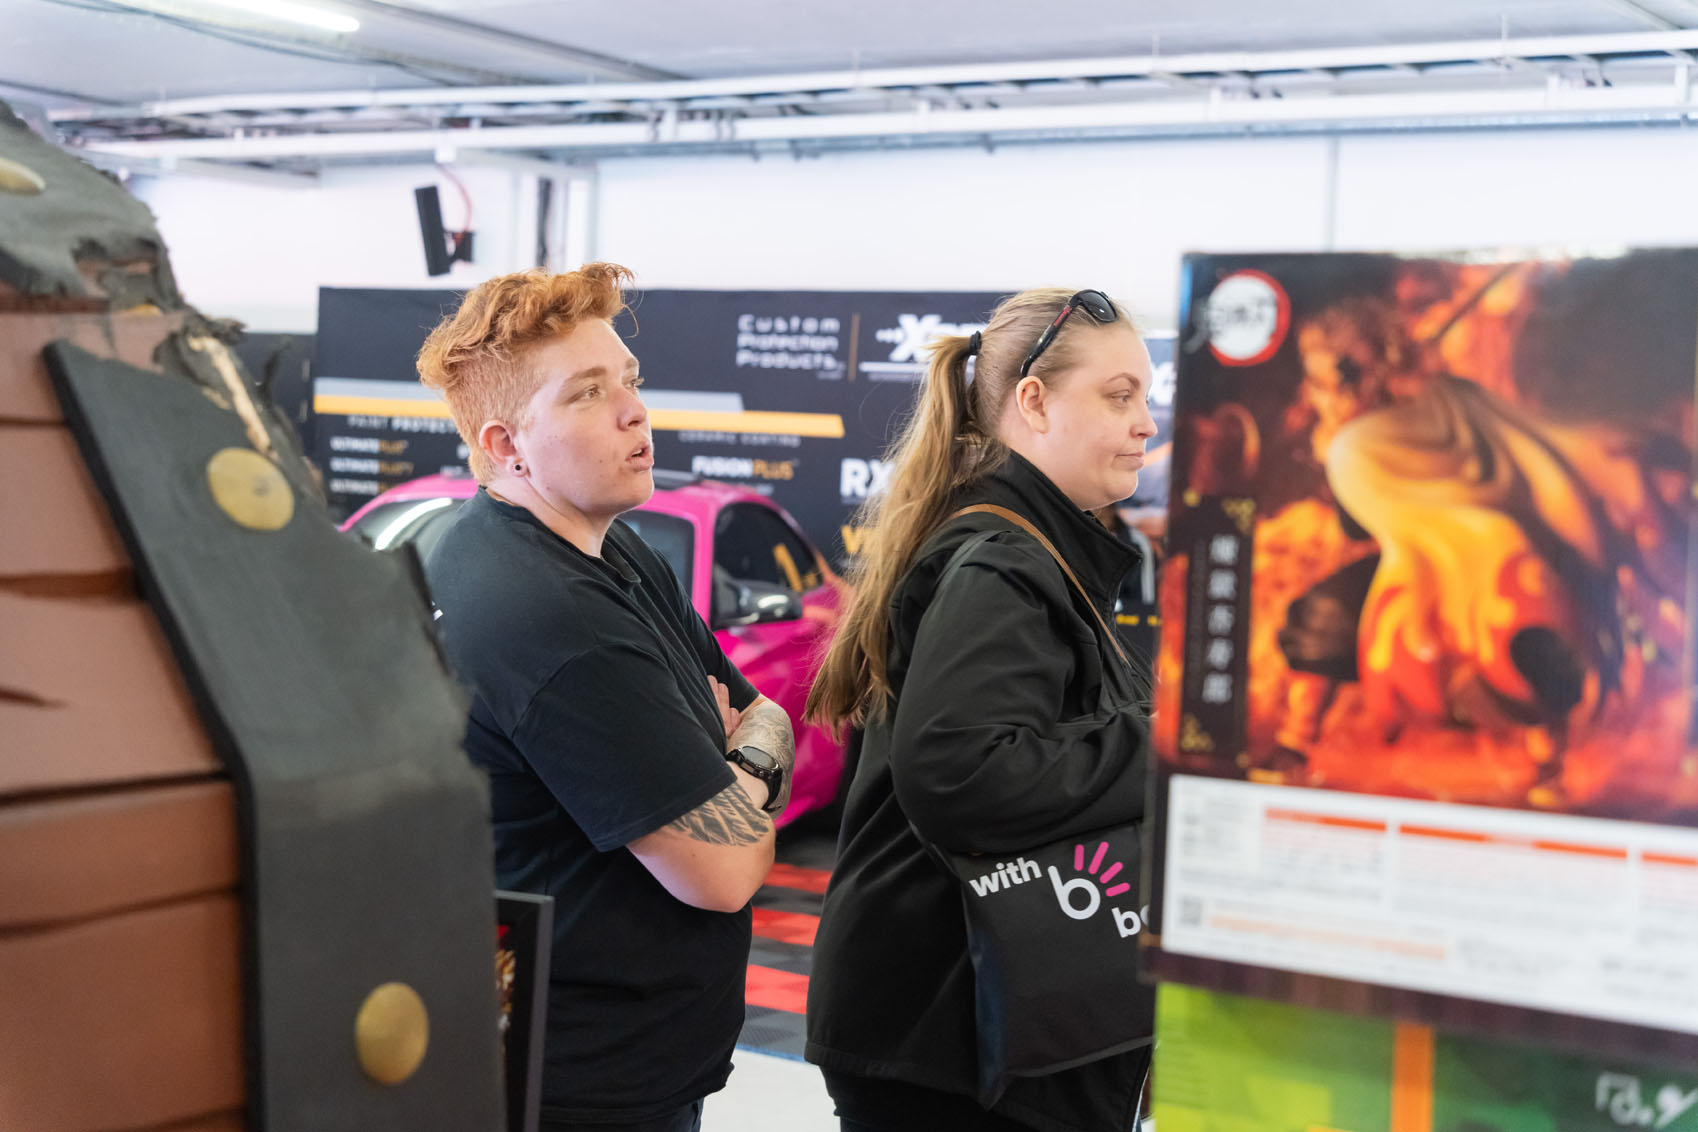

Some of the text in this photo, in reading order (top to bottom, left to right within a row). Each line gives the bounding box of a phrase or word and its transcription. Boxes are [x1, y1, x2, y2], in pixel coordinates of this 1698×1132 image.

[738, 314, 840, 334] Custom
[737, 333, 839, 352] Protection
[968, 857, 1043, 897] with
